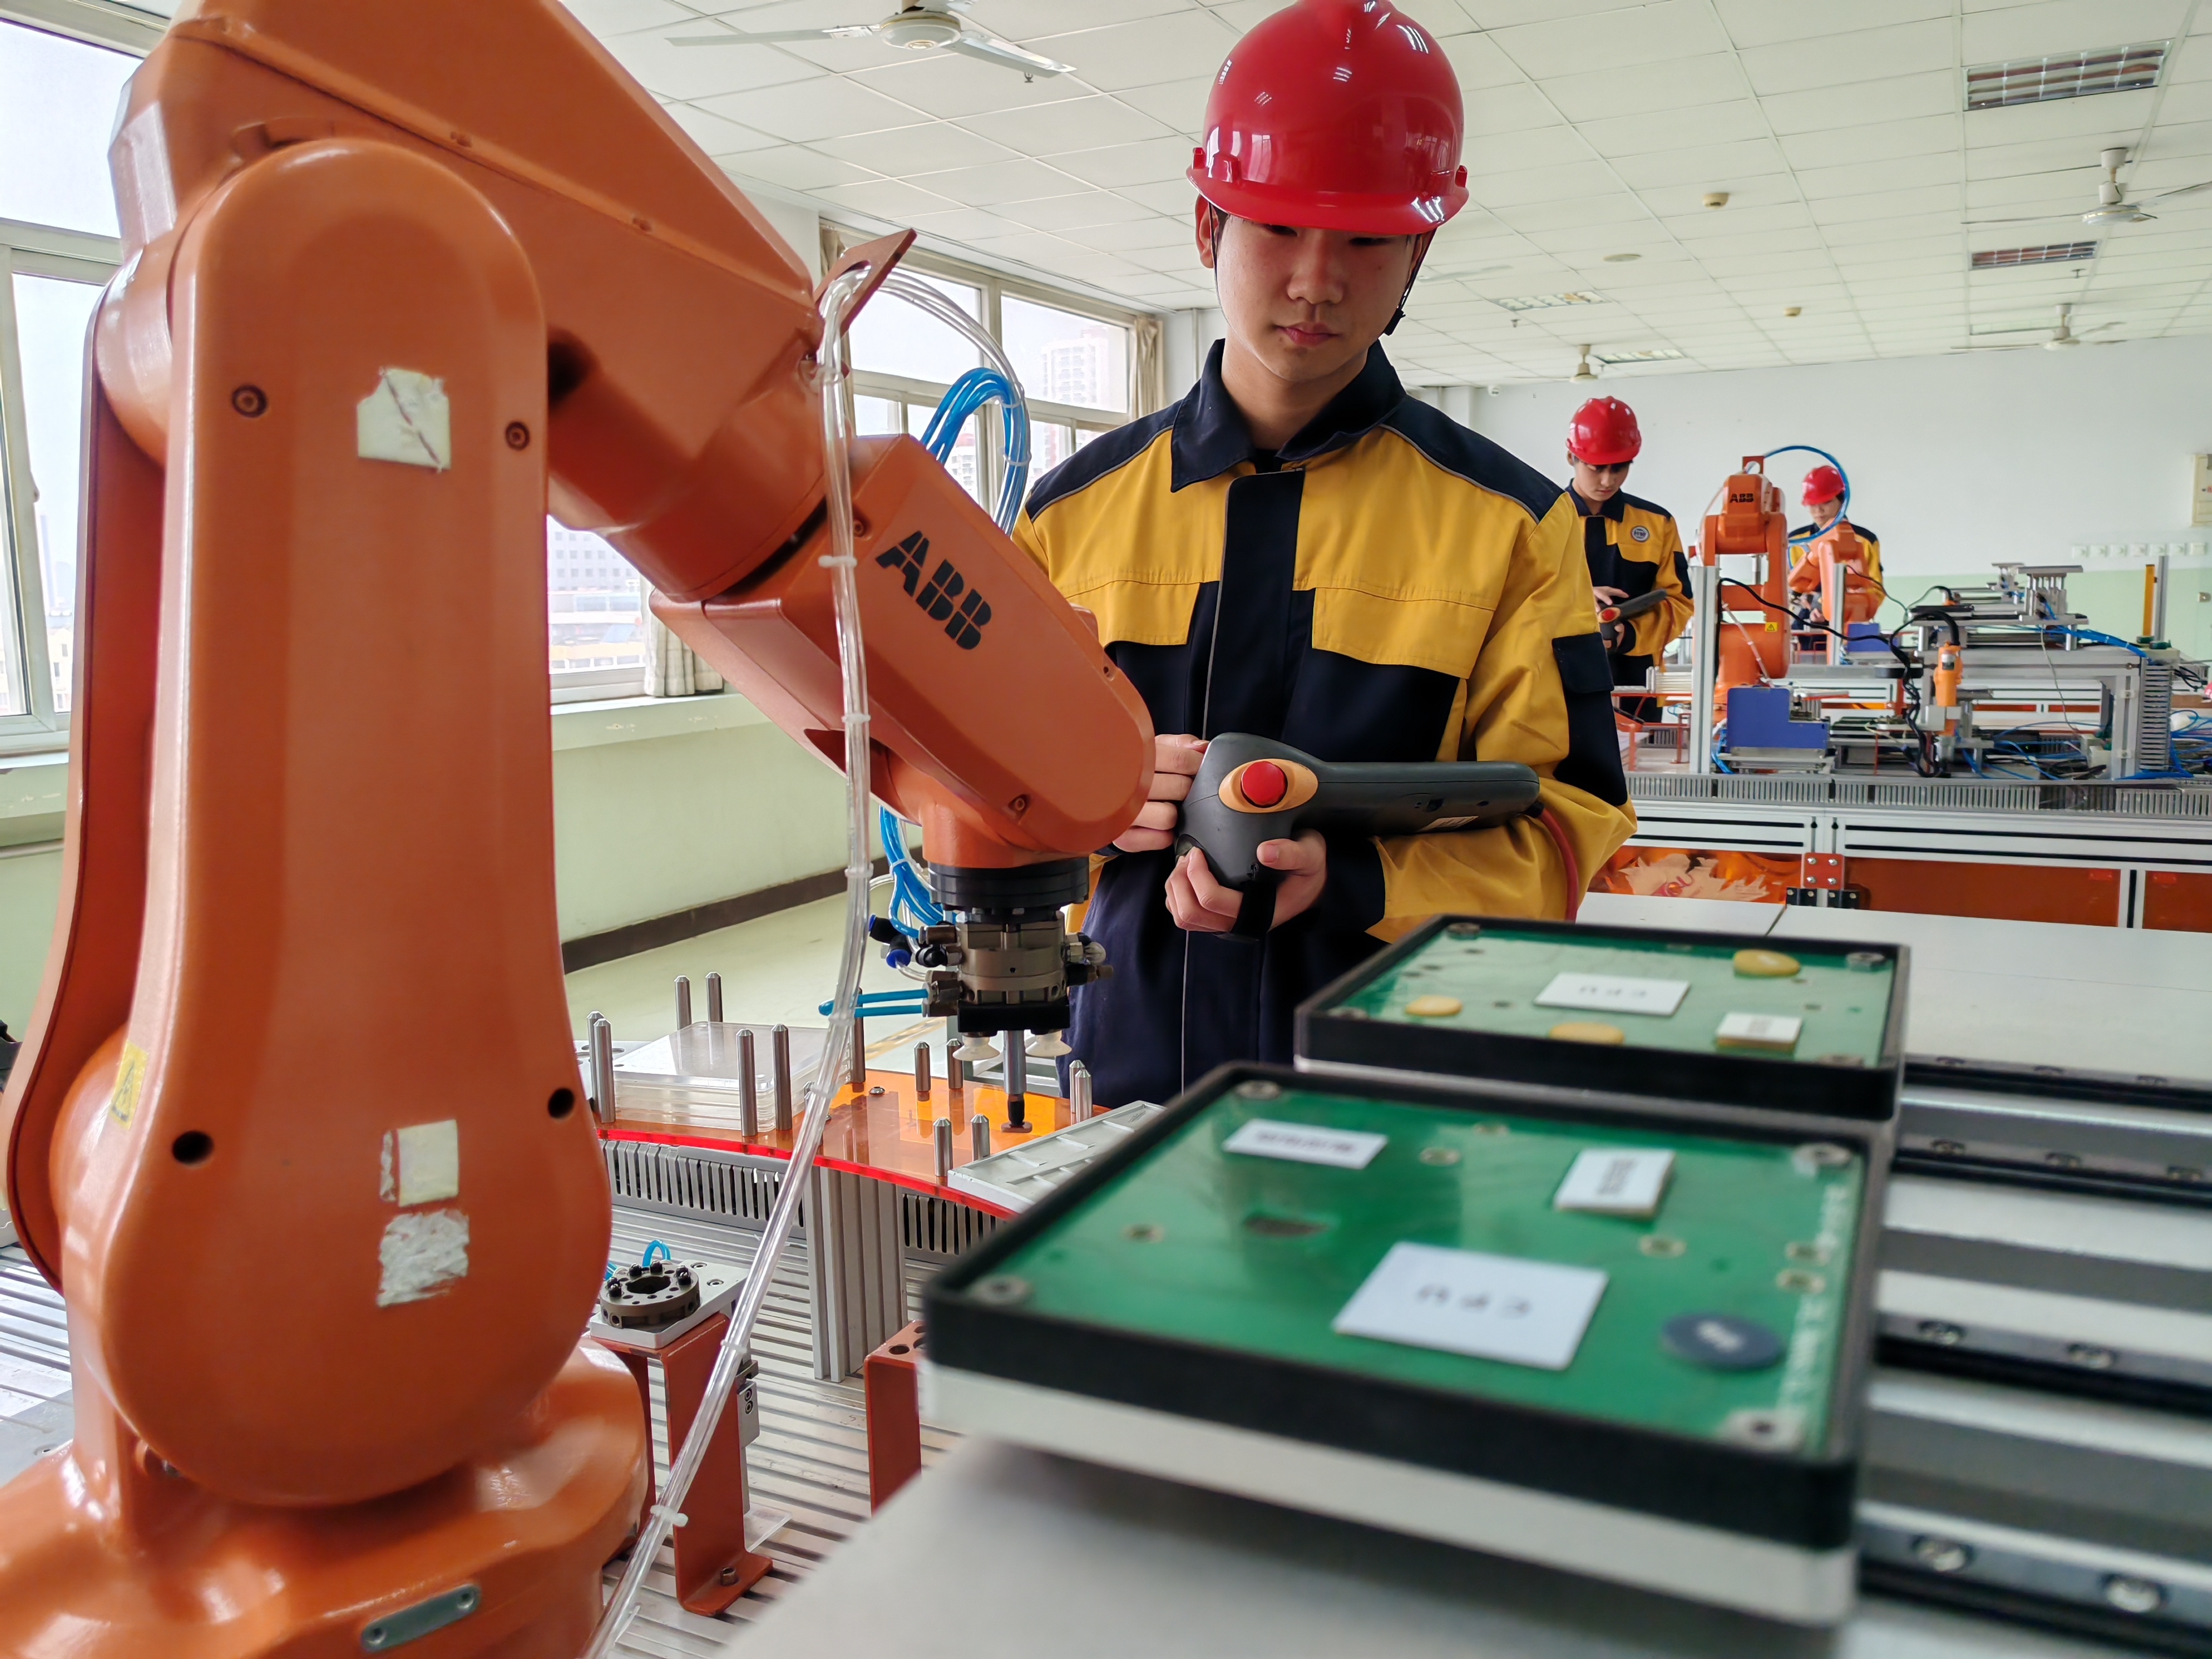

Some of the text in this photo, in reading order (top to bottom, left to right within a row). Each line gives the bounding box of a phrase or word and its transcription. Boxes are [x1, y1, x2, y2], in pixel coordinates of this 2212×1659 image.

[1729, 493, 1755, 503] ABB
[875, 530, 992, 650] ABB
[1416, 1282, 1533, 1318] CPU
